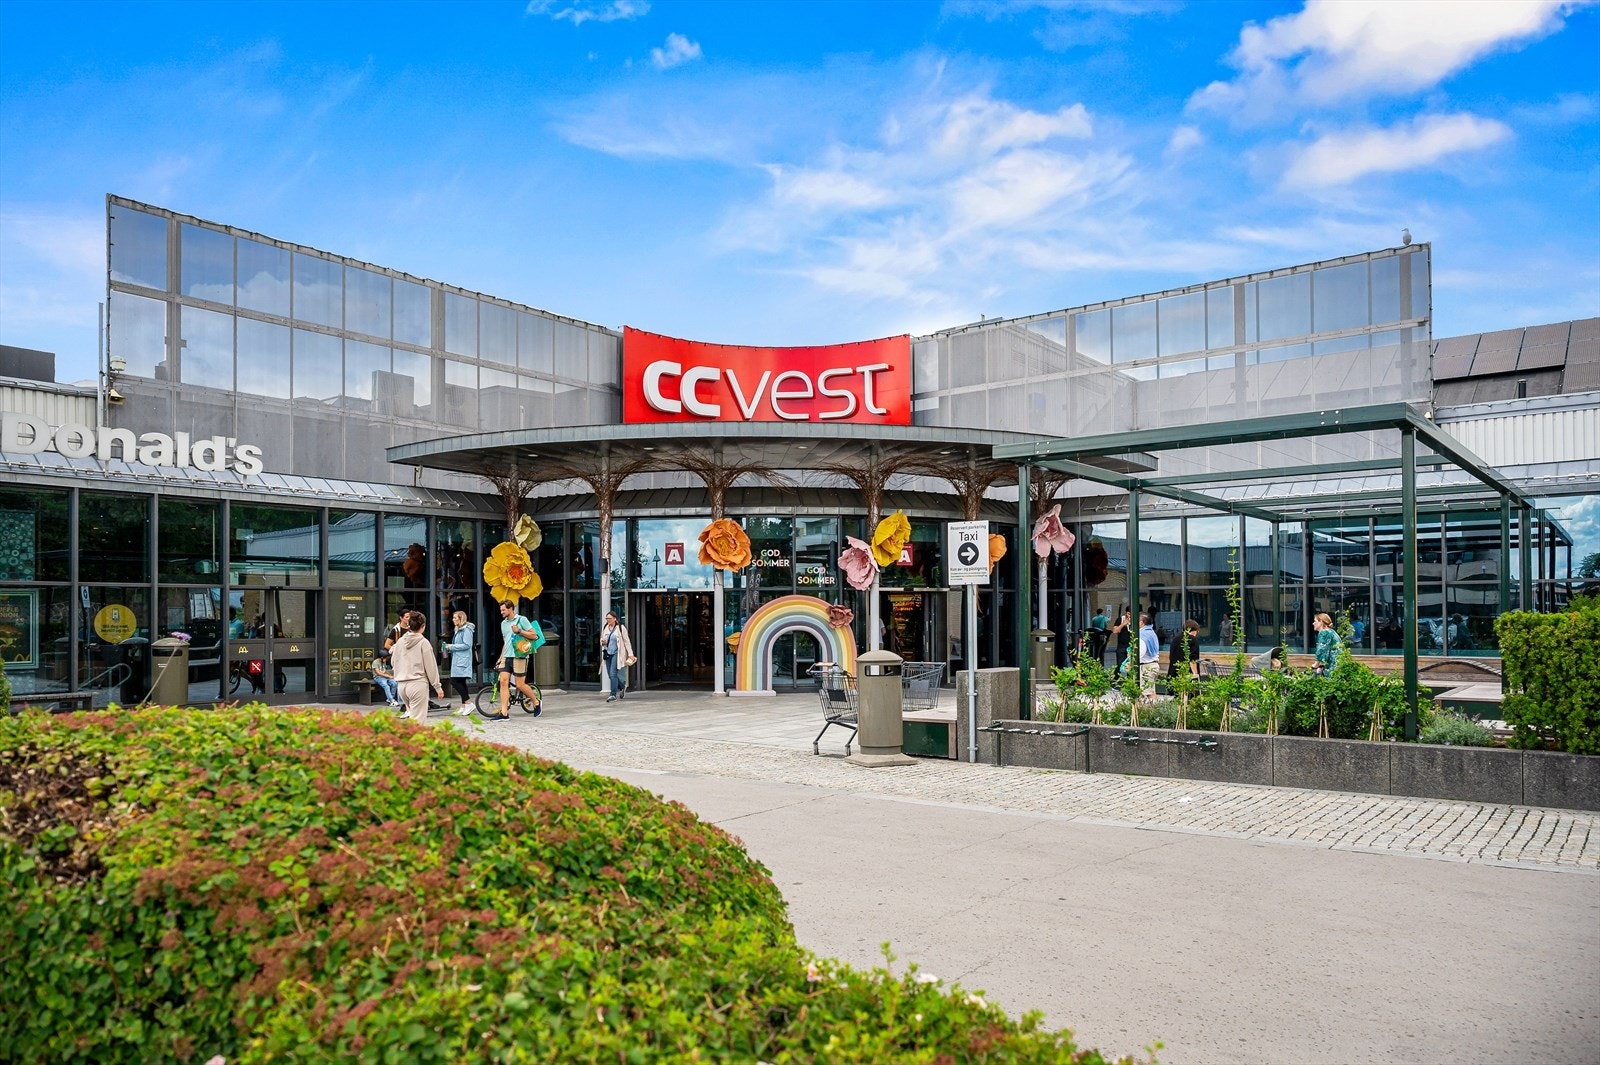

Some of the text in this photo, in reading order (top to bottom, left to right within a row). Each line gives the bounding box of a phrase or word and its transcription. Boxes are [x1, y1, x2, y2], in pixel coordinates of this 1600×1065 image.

[0, 411, 264, 475] Donald's
[959, 531, 978, 541] Taxi
[667, 549, 682, 562] A
[760, 549, 781, 557] GOD
[751, 559, 790, 568] SOMMER
[807, 566, 826, 574] GOD
[797, 576, 835, 585] SOMMER
